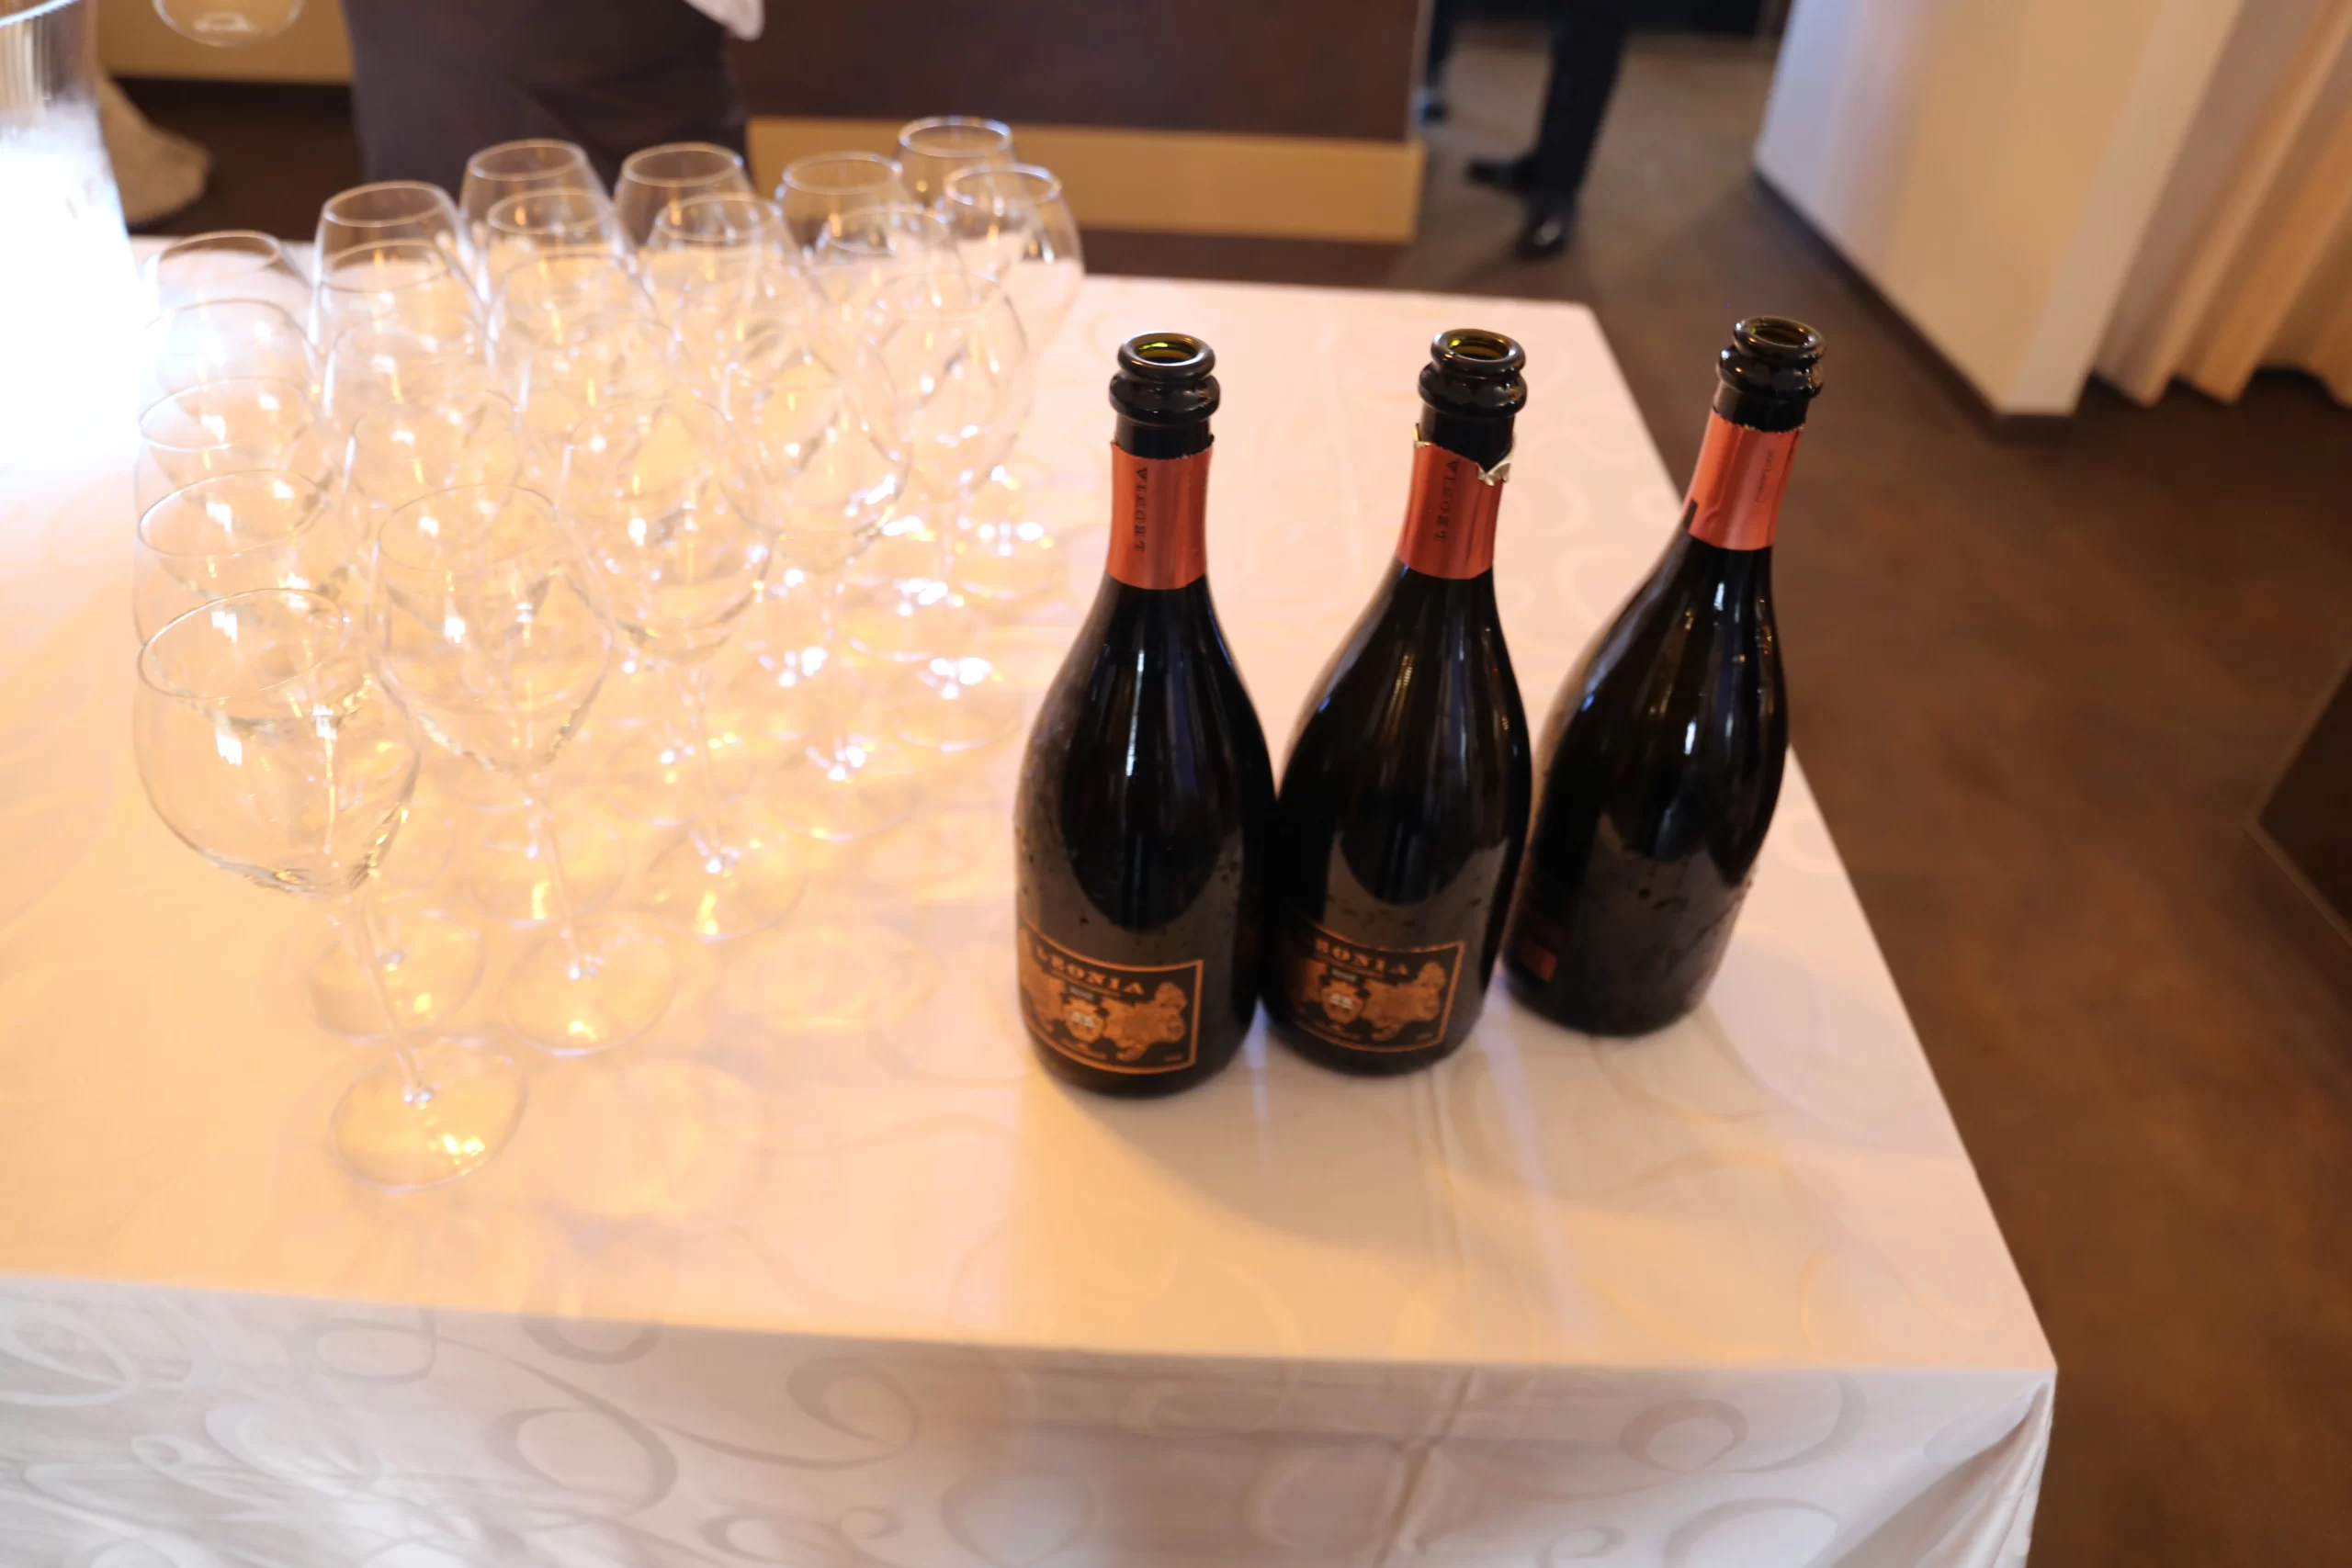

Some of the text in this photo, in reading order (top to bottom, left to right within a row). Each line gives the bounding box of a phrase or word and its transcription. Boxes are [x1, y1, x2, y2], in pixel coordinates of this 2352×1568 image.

[1134, 467, 1148, 552] LEONIA
[1434, 459, 1459, 542] LEONIA
[1035, 945, 1145, 996] LEONIA
